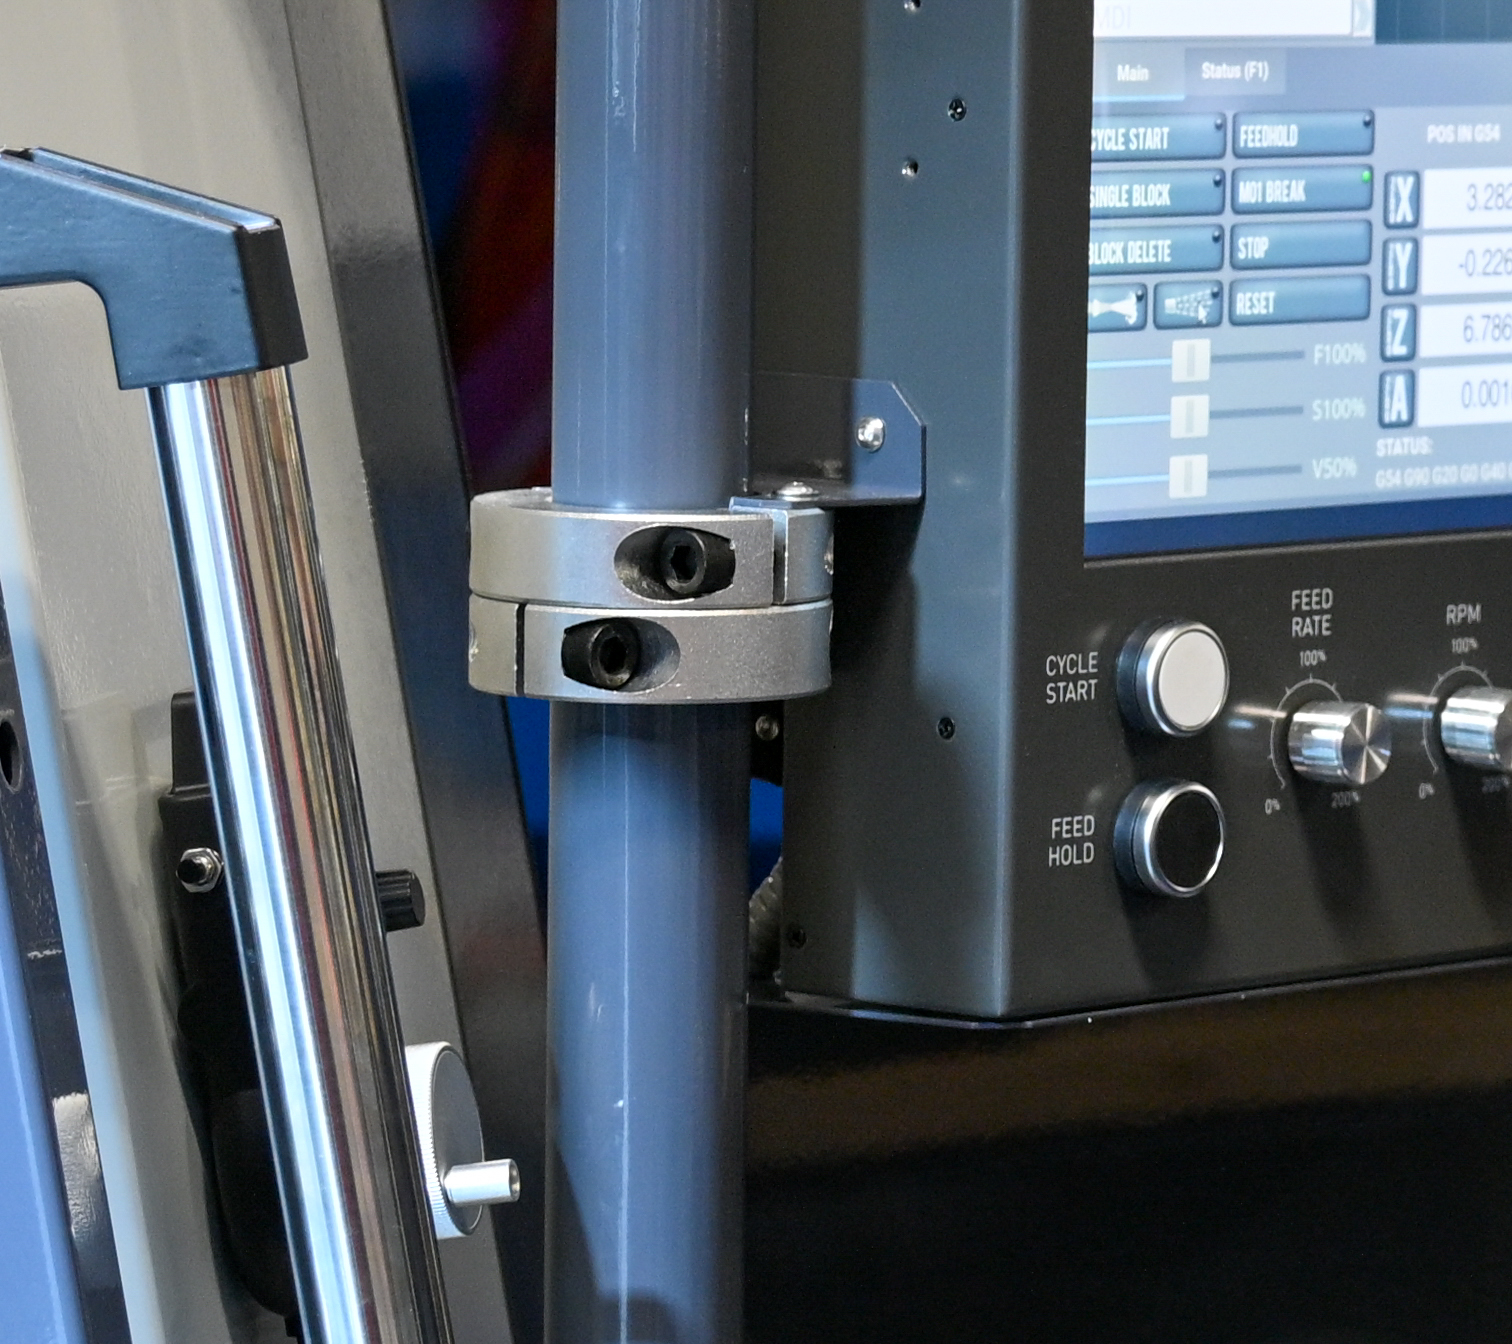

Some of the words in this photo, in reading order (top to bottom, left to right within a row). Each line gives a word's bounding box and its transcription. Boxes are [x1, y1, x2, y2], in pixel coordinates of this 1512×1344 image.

[1117, 64, 1149, 81] Main
[1202, 61, 1241, 80] Status
[1244, 60, 1269, 82] (F1)
[1091, 127, 1126, 151] CYCLE
[1129, 126, 1169, 151] START
[1239, 124, 1298, 148] FEEDHOLD
[1090, 184, 1129, 209] SINGLE
[1132, 183, 1171, 207] BLOCK
[1239, 180, 1264, 204] M01
[1266, 179, 1306, 203] BREAK
[1127, 239, 1172, 264] DELETE
[1238, 236, 1269, 260] STOP
[1235, 291, 1276, 316] RESET
[1313, 343, 1367, 366] F100%
[1312, 397, 1366, 422] S100%
[1376, 434, 1434, 458] STATUS:
[1312, 457, 1357, 480] V50%
[1291, 588, 1334, 611] FEED
[1291, 614, 1333, 637] RATE
[1446, 603, 1482, 627] RPM
[1299, 648, 1328, 666] 100%
[1451, 636, 1480, 654] 100%
[1046, 651, 1099, 677] CYCLE
[1046, 678, 1099, 705] START
[1264, 798, 1281, 815] 0%
[1051, 814, 1096, 839] FEED
[1048, 842, 1096, 868] HOLD
